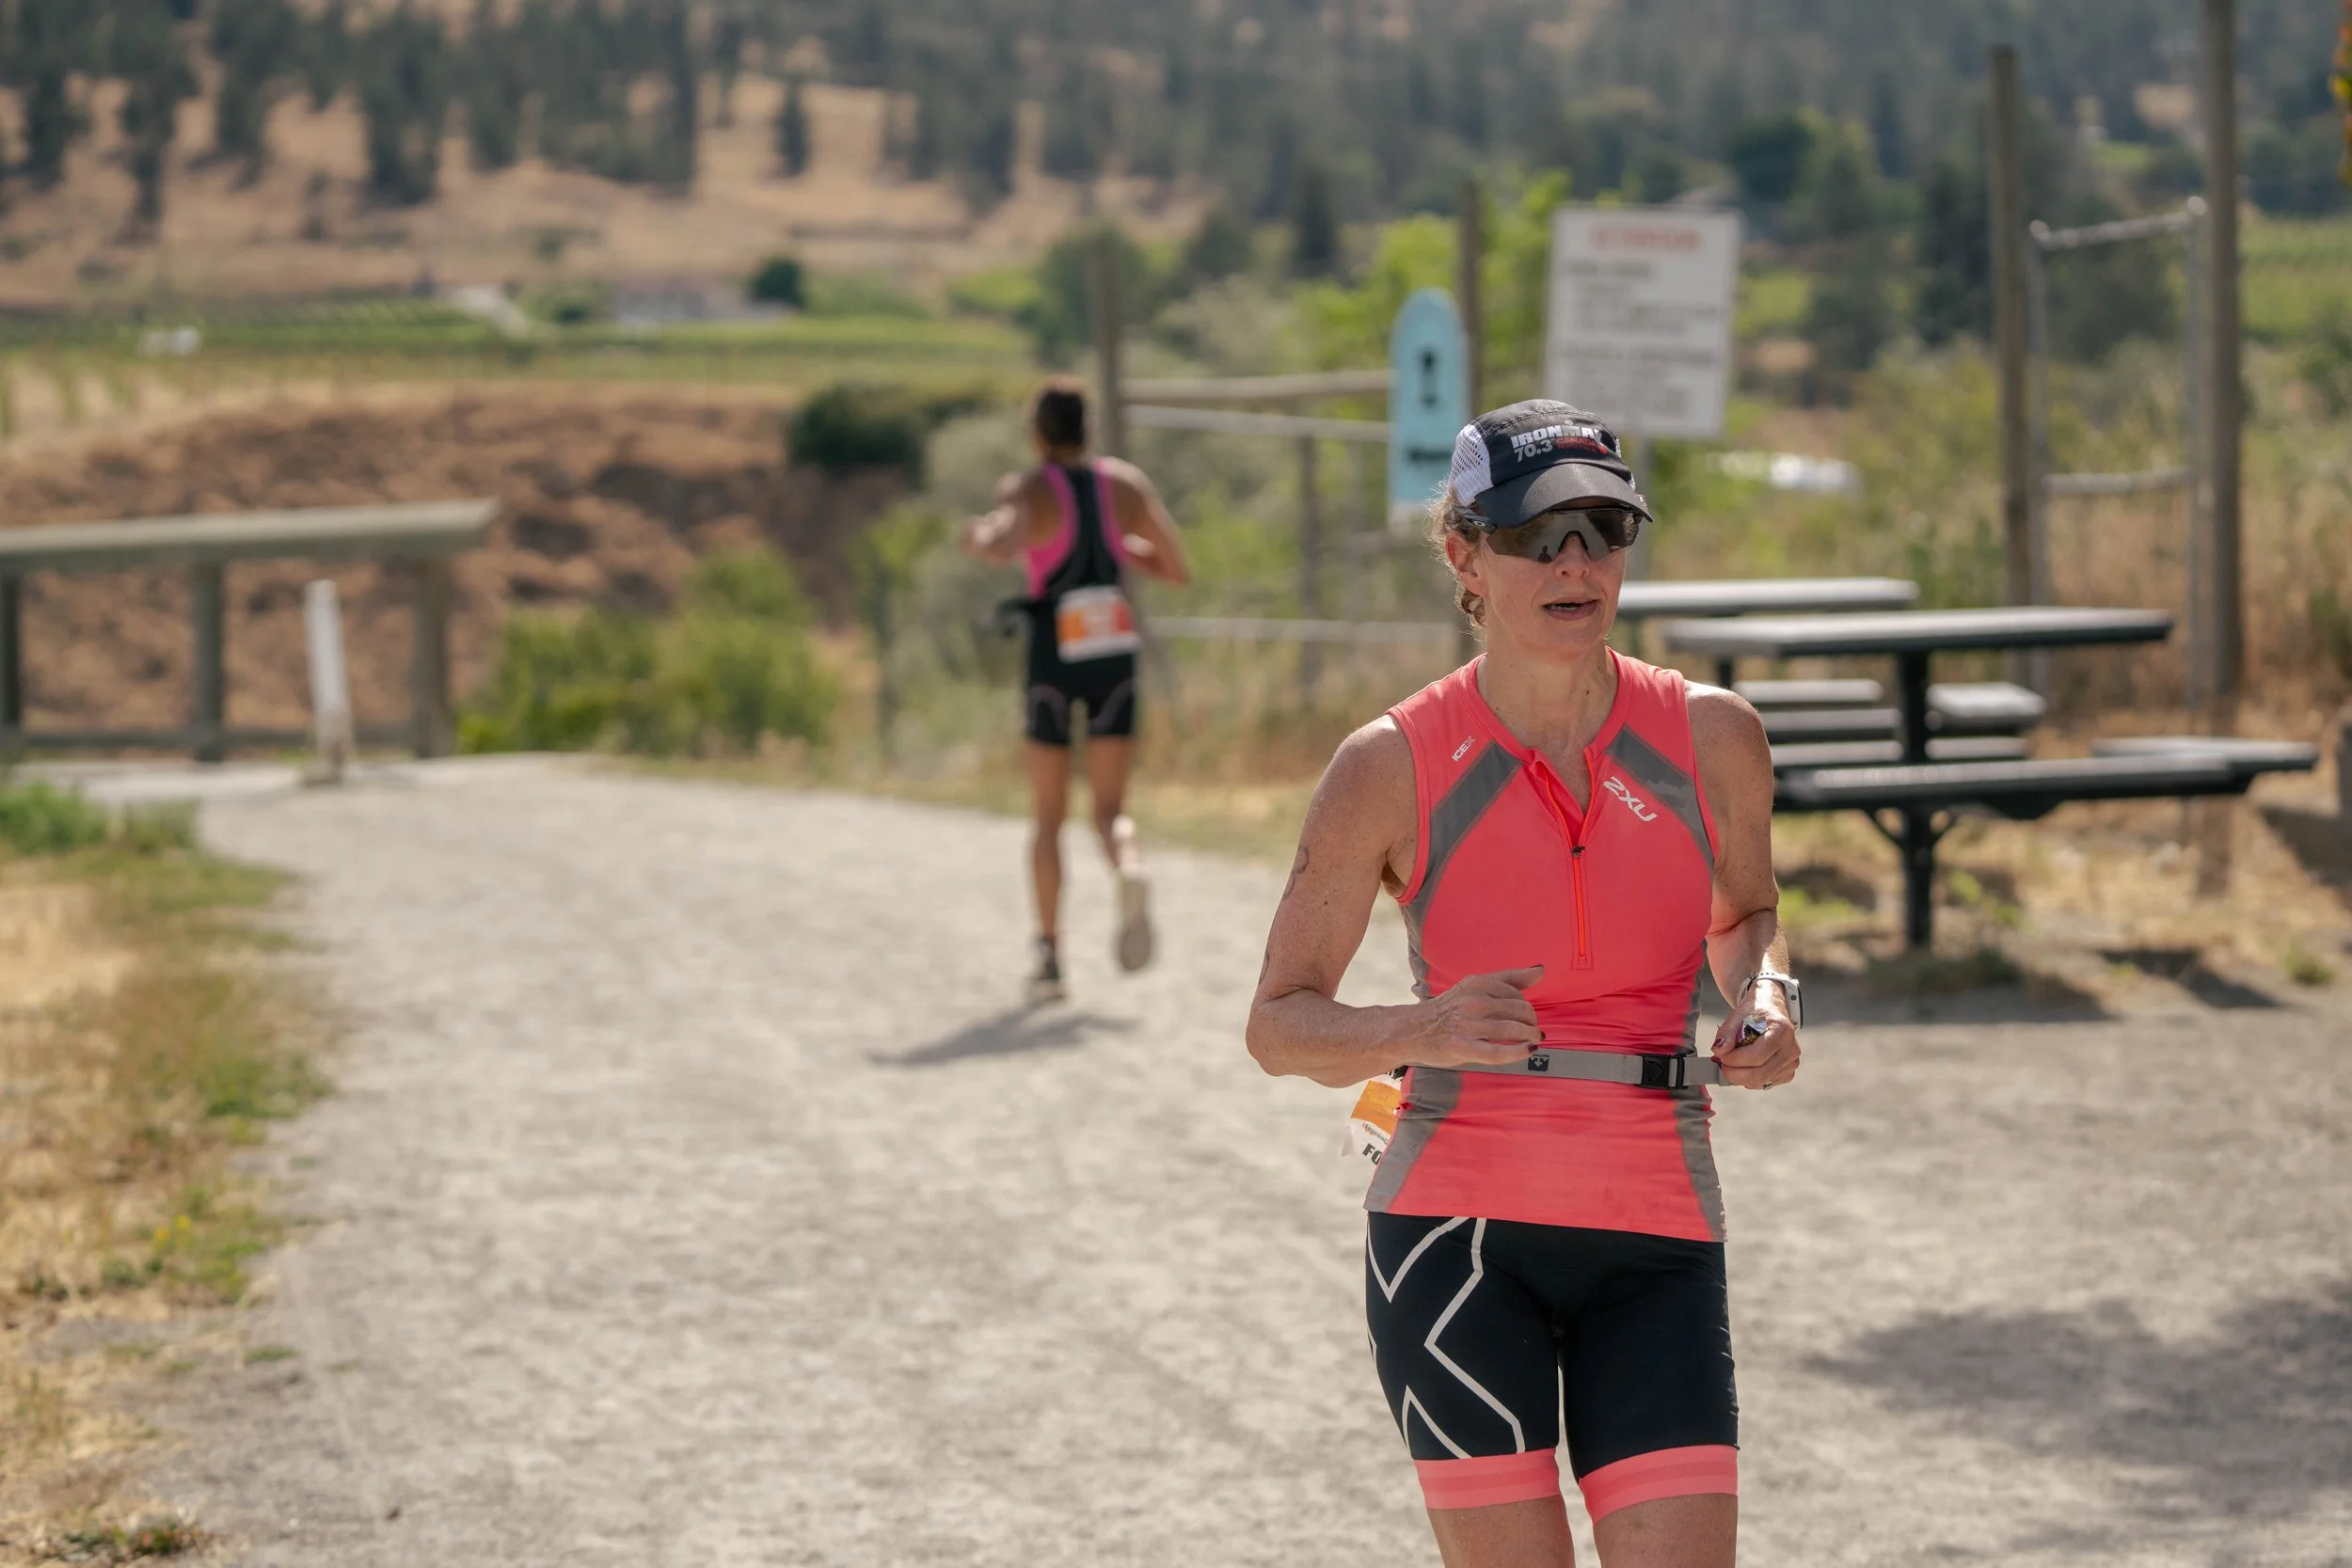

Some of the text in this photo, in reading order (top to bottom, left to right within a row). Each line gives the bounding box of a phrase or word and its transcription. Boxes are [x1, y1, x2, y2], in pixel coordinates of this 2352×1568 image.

[1514, 439, 1553, 463] 70.3
[1452, 736, 1475, 761] ICEX
[1603, 776, 1658, 821] 2XU
